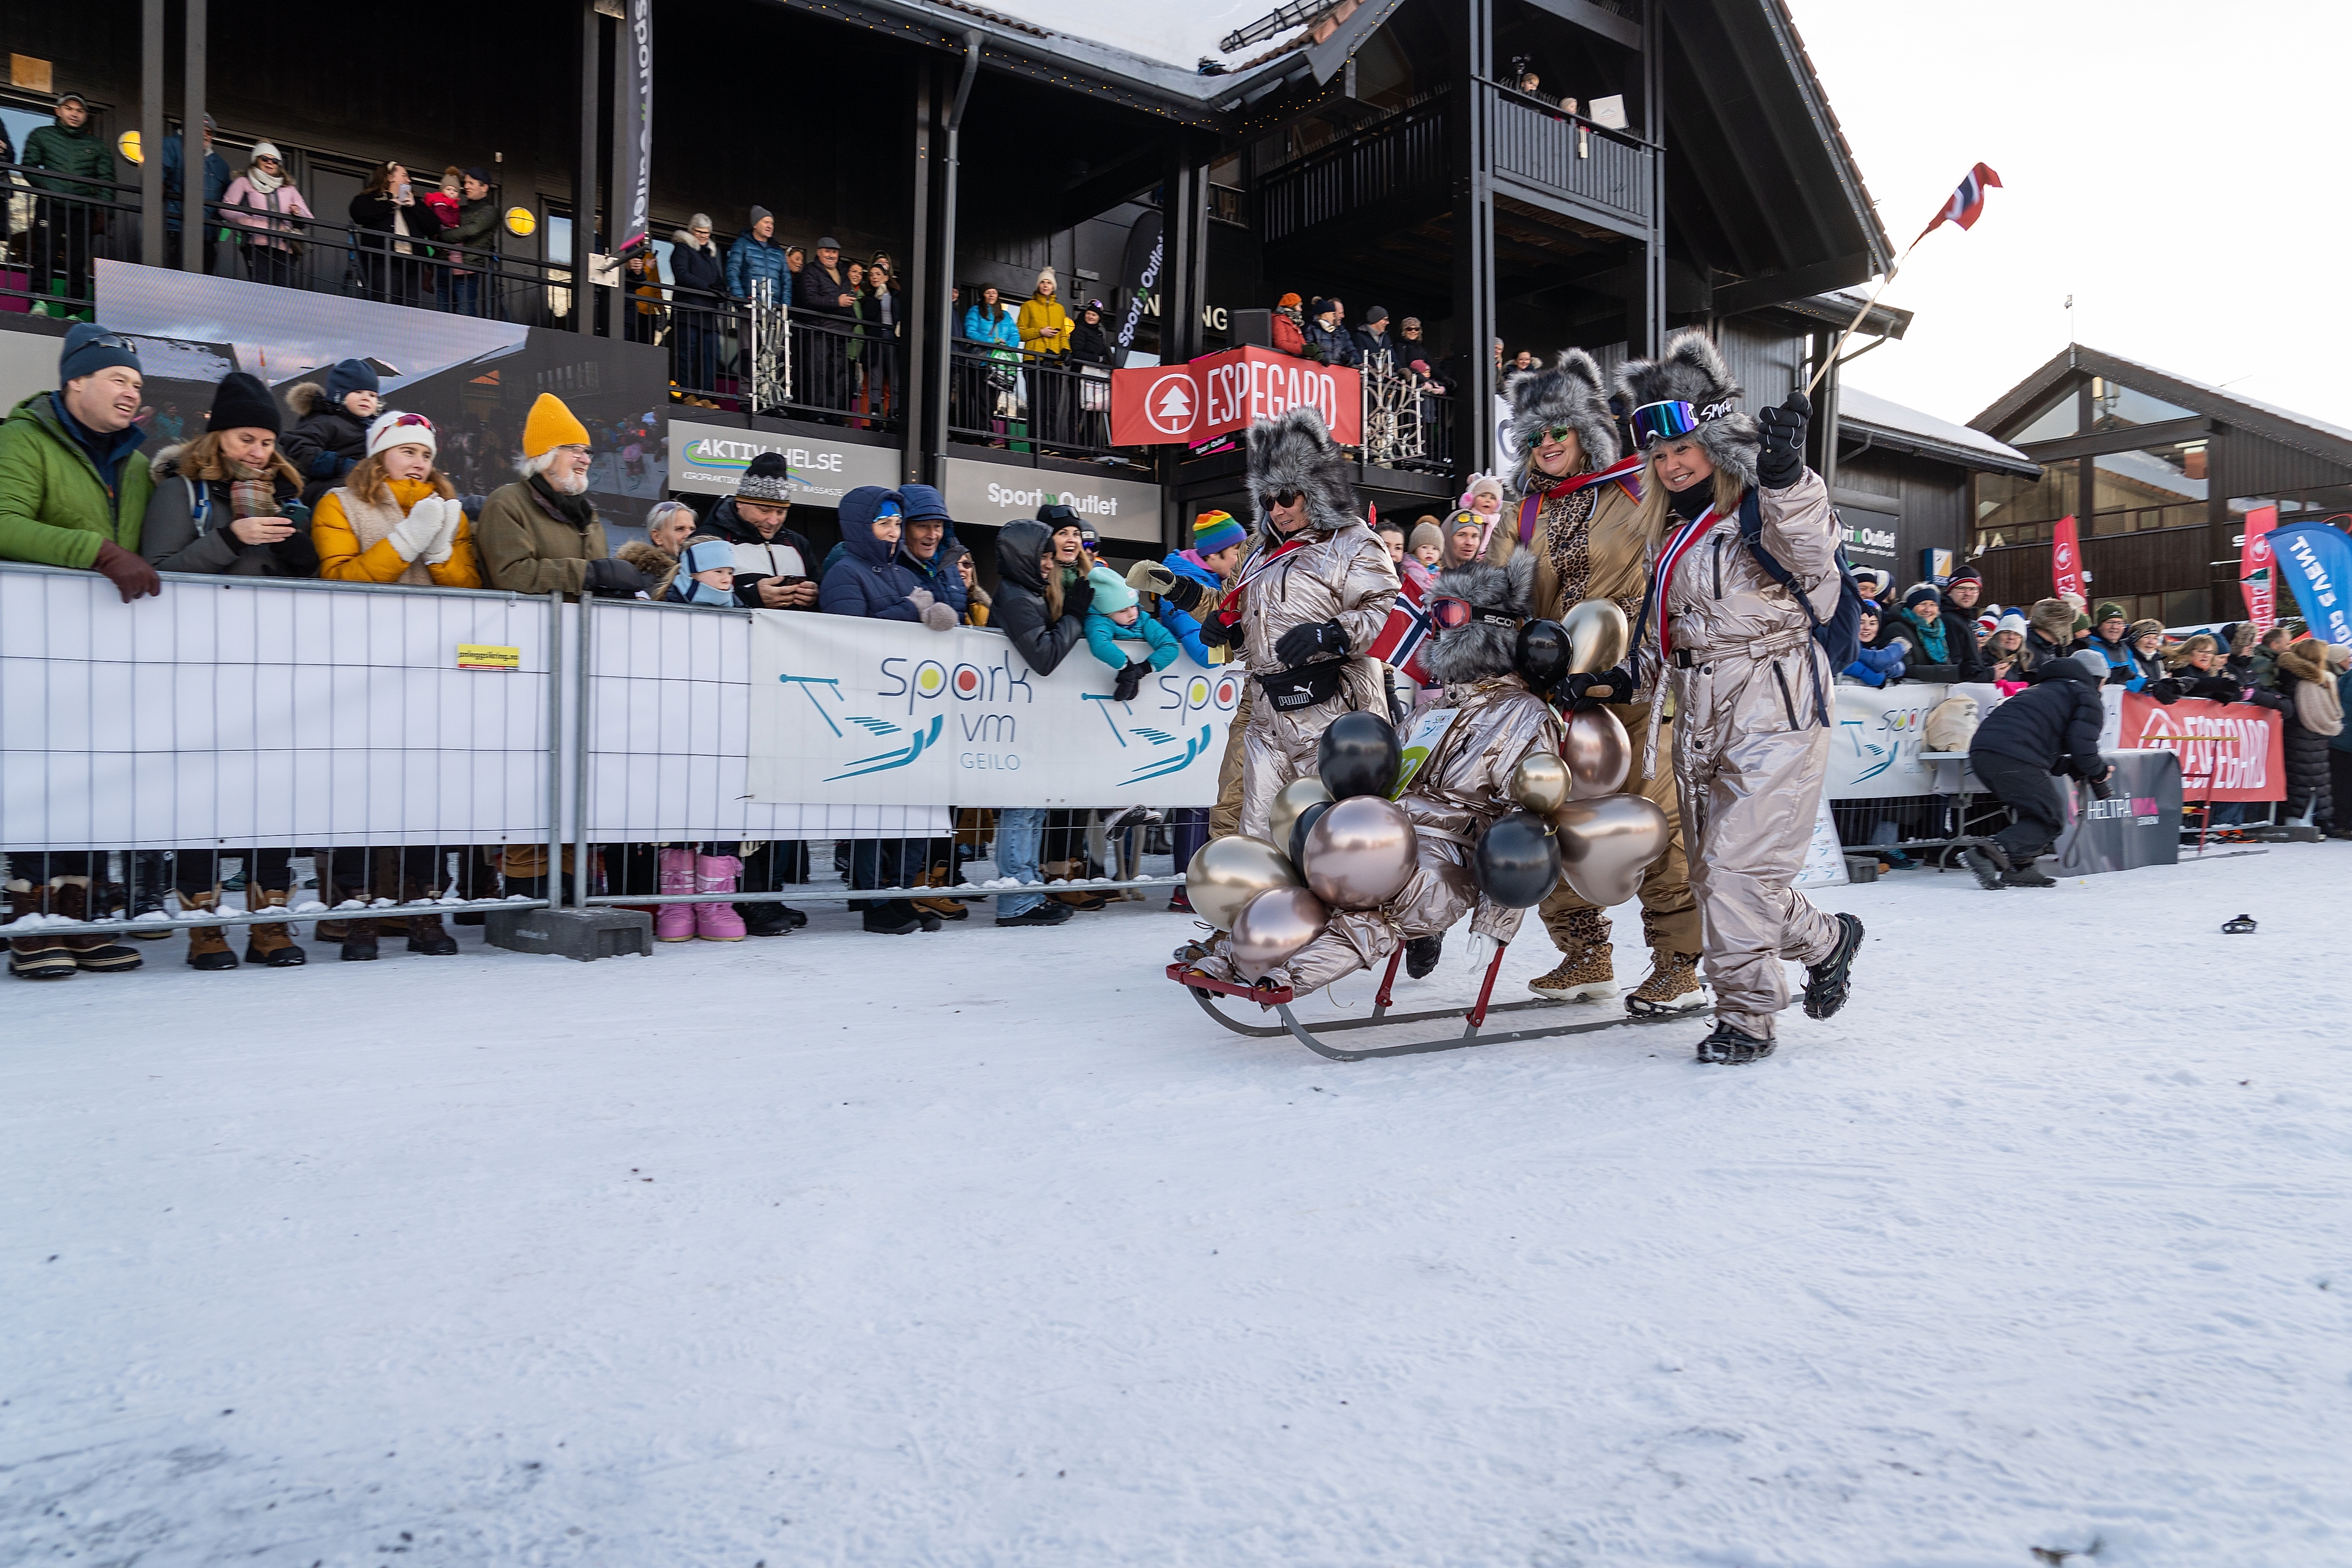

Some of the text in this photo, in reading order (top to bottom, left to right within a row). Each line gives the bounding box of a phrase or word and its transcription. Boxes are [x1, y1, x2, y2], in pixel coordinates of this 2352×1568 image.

[1118, 296, 1144, 347] Sport
[1207, 360, 1337, 431] ESPEGARD
[696, 438, 843, 473] AKTIV HELSE
[987, 483, 1118, 516] Sport Outlet
[1861, 527, 1896, 549] Outlet
[1483, 614, 1517, 628] SCOT
[878, 649, 1033, 715] spark
[1159, 675, 1240, 726] spa
[1278, 693, 1310, 706] PUMA
[960, 713, 1016, 743] vm
[959, 752, 1022, 771] GEILO
[1390, 758, 1417, 795] 2
